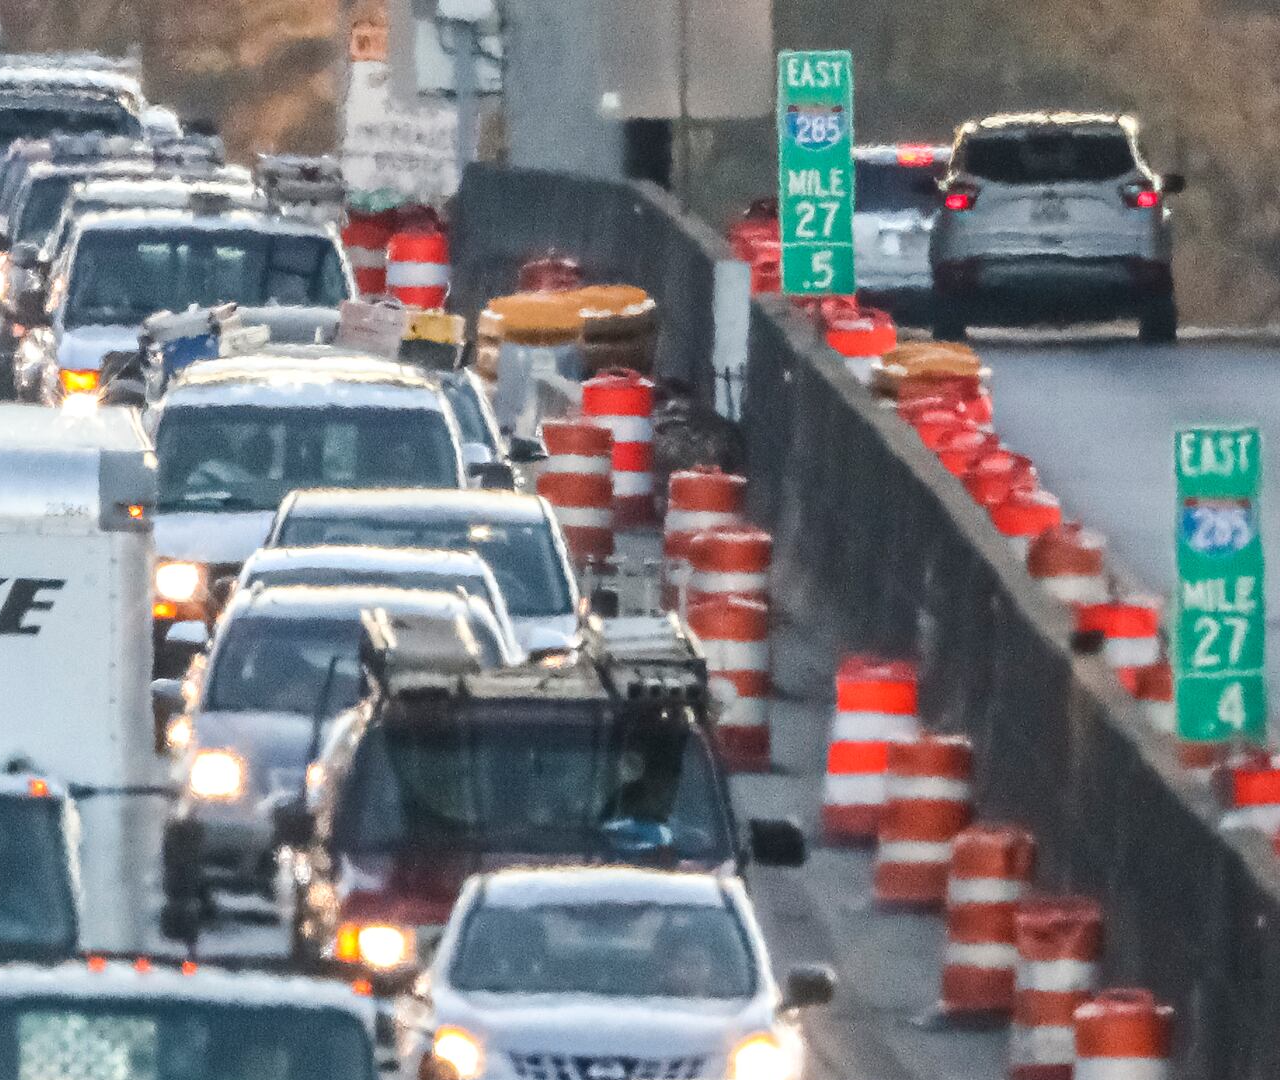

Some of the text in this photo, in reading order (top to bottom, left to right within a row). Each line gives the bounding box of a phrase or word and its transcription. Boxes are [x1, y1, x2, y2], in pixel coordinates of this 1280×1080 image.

[787, 58, 842, 88] EAST
[796, 115, 842, 143] 285
[788, 168, 845, 197] MILE
[795, 201, 840, 238] 27
[1181, 432, 1253, 477] EAST
[1183, 575, 1256, 613] MILE
[1193, 615, 1249, 667] 27
